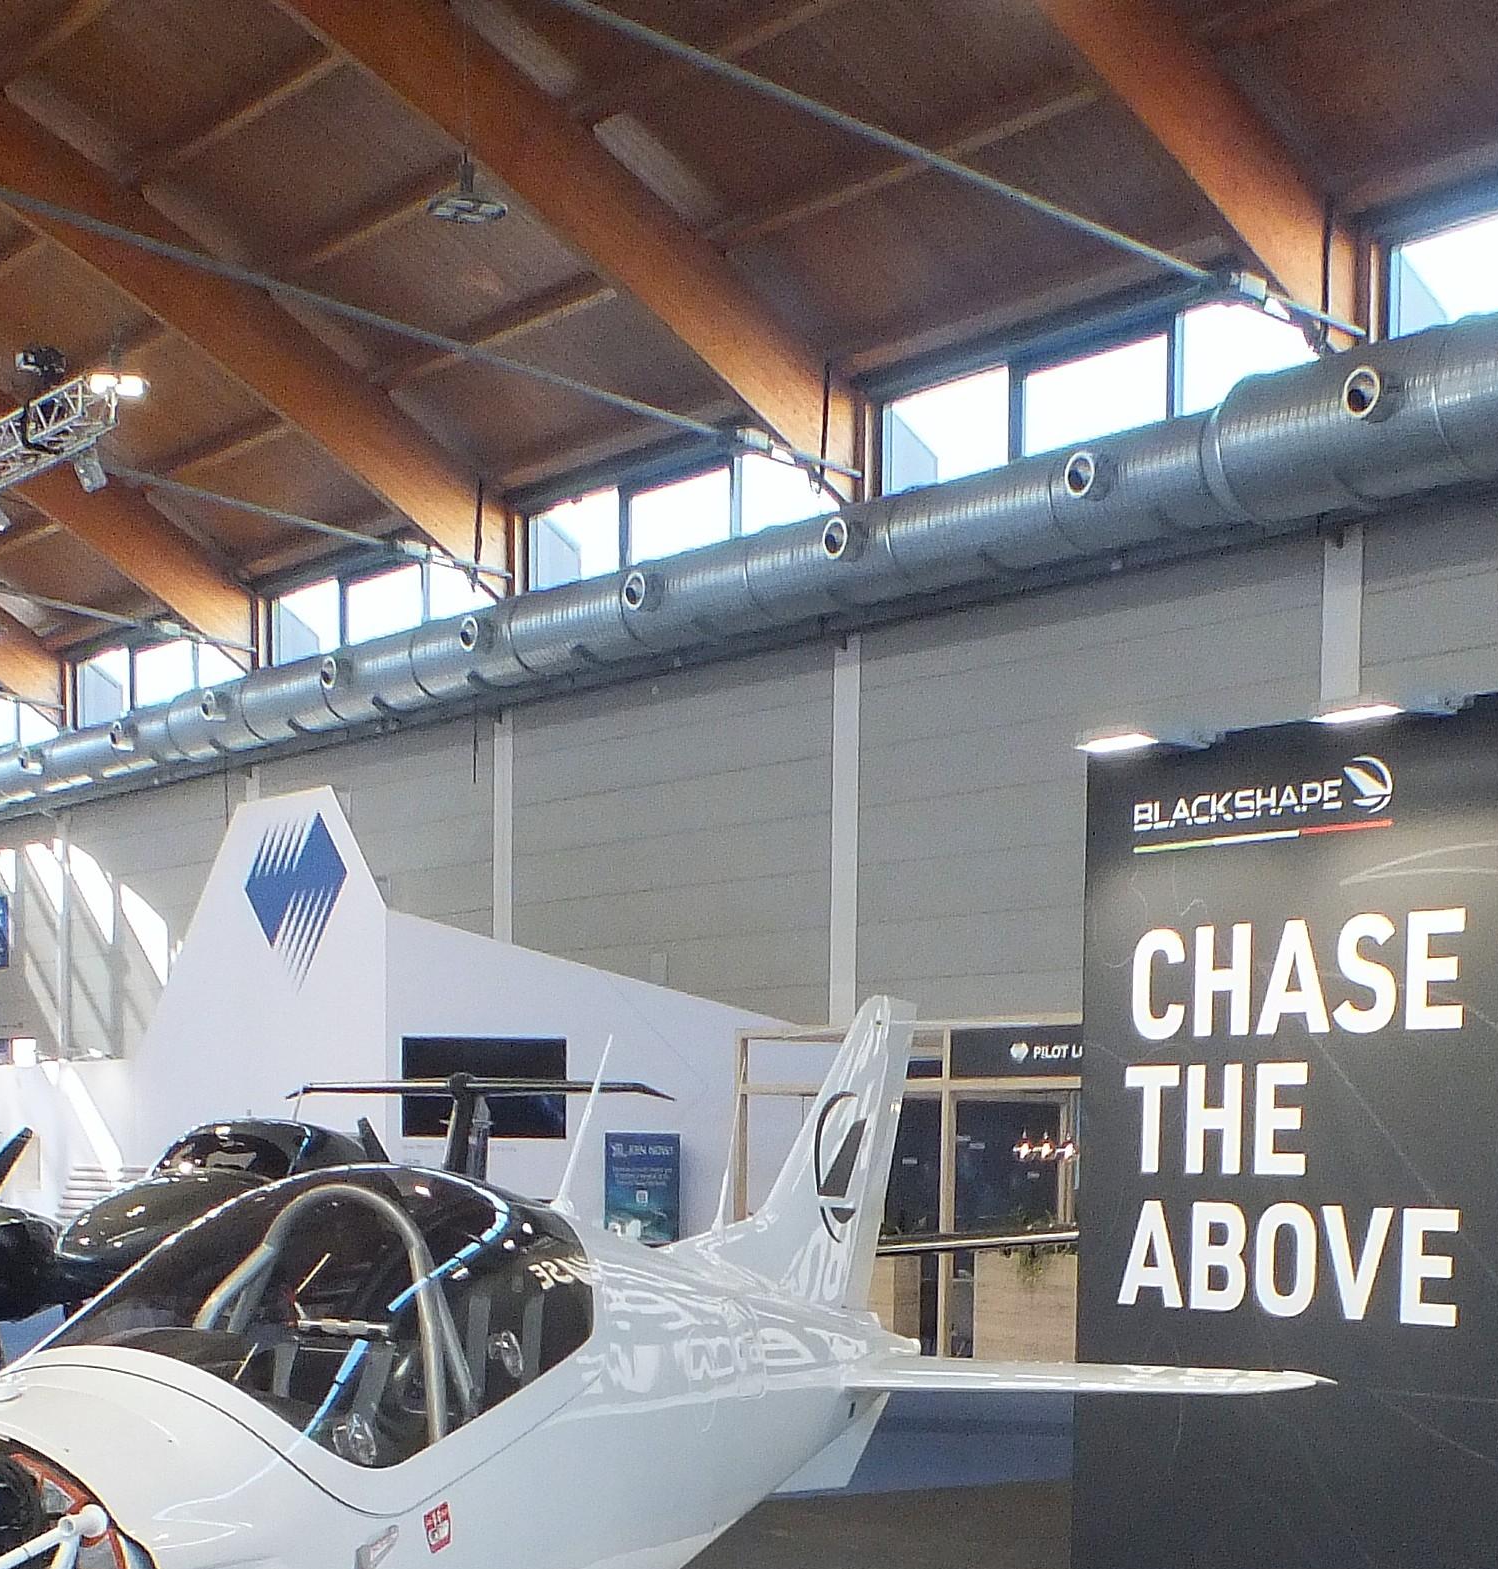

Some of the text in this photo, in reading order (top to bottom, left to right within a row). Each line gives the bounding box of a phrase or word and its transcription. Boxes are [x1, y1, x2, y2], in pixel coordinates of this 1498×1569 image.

[1133, 777, 1343, 832] BLACKSHAPE
[1131, 906, 1467, 1041] CHASE
[1033, 1044, 1069, 1060] PILOT
[1124, 1060, 1309, 1176] THE
[1117, 1200, 1460, 1328] ABOVE
